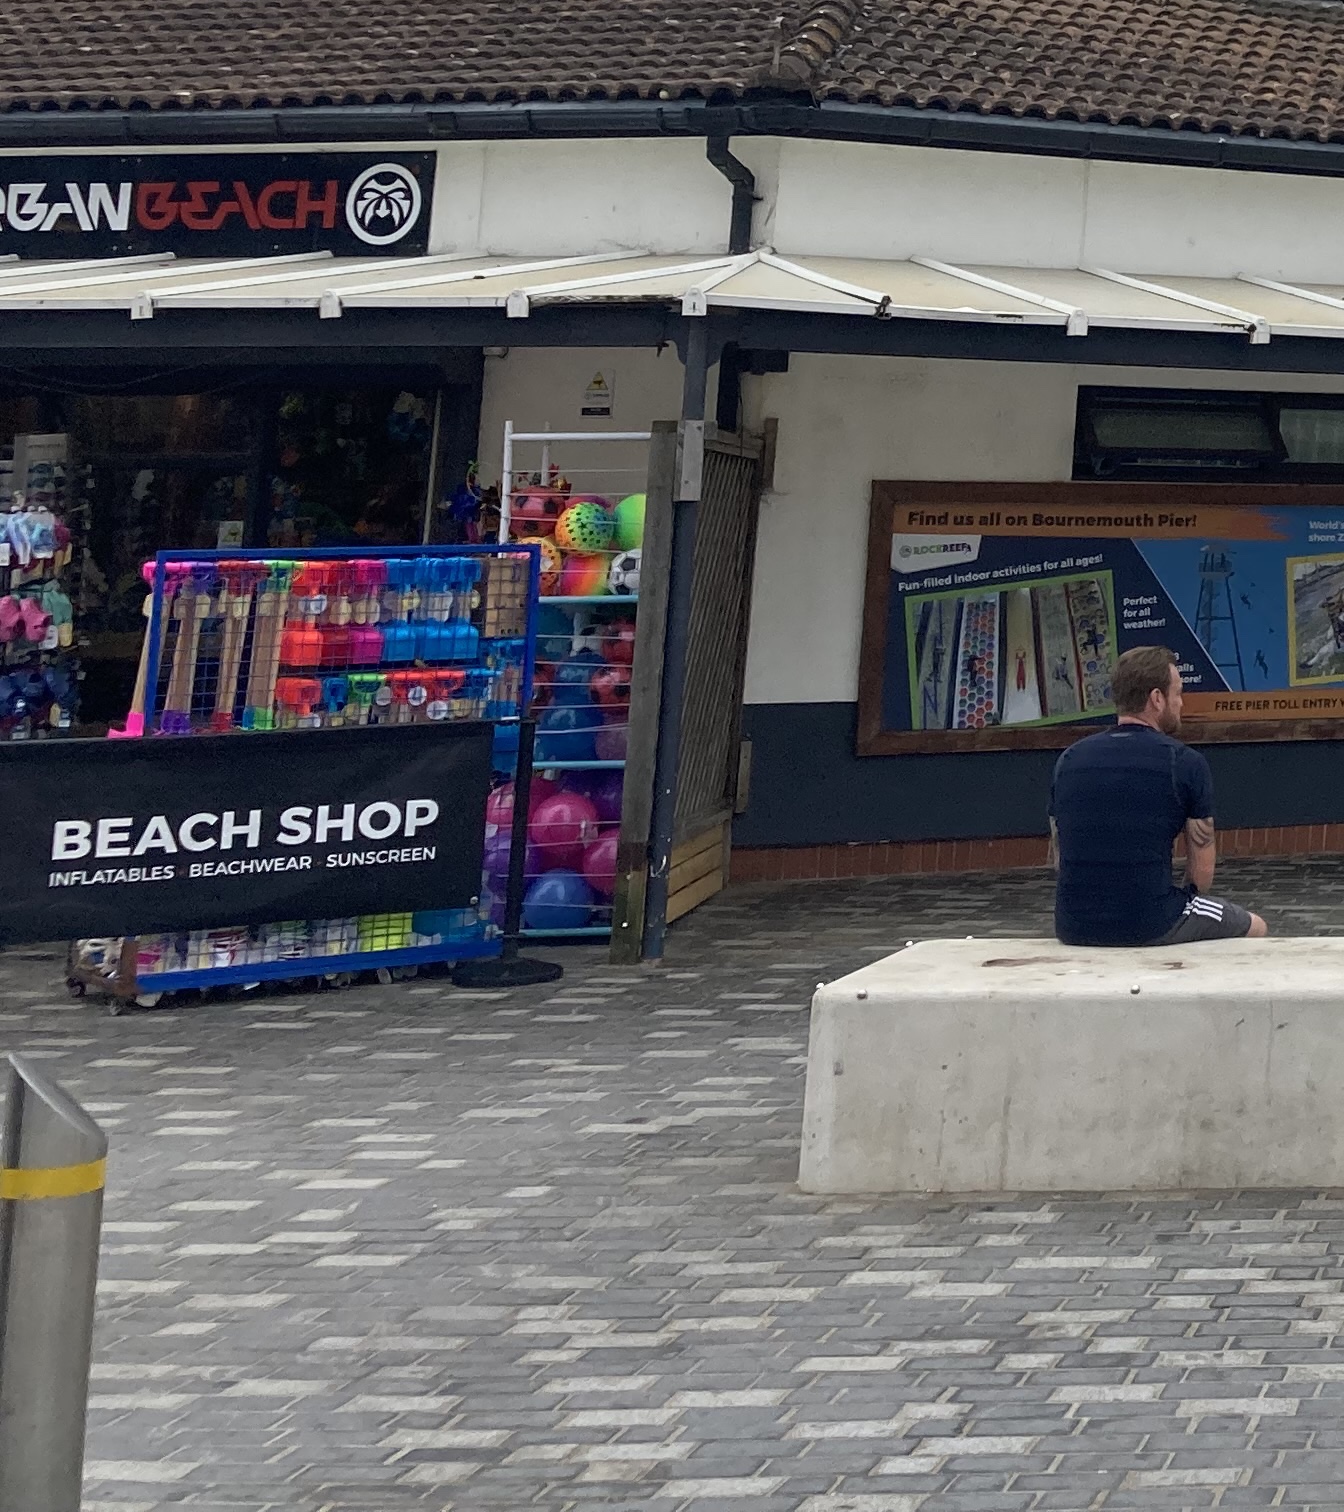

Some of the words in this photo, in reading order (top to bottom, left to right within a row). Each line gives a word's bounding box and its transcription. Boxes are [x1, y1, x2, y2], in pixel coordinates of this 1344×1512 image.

[906, 510, 948, 526] Find
[953, 513, 974, 526] us
[979, 510, 1002, 526] all
[1005, 514, 1028, 526] on
[1031, 512, 1154, 528] Bournemouth
[1157, 513, 1198, 528] Pier!
[898, 573, 952, 593] Fun-filled
[993, 561, 1042, 579] activities
[1043, 559, 1059, 574] for
[1060, 557, 1074, 569] all
[1075, 553, 1104, 569] ages!
[1123, 595, 1158, 606] Perfect
[1123, 608, 1137, 618] for
[1138, 607, 1151, 617] all
[1123, 618, 1166, 629] weather!
[1180, 674, 1202, 683] ore!
[1214, 701, 1243, 711] FREE
[1245, 700, 1270, 710] PIER
[1272, 699, 1299, 710] TOLL
[1302, 698, 1338, 709] ENTRY
[51, 808, 262, 861] BEACH
[276, 798, 440, 846] SHOP
[48, 864, 175, 888] INFLATABLES
[188, 854, 312, 879] BEACHWEAR
[325, 845, 437, 869] SUNSCREEN
